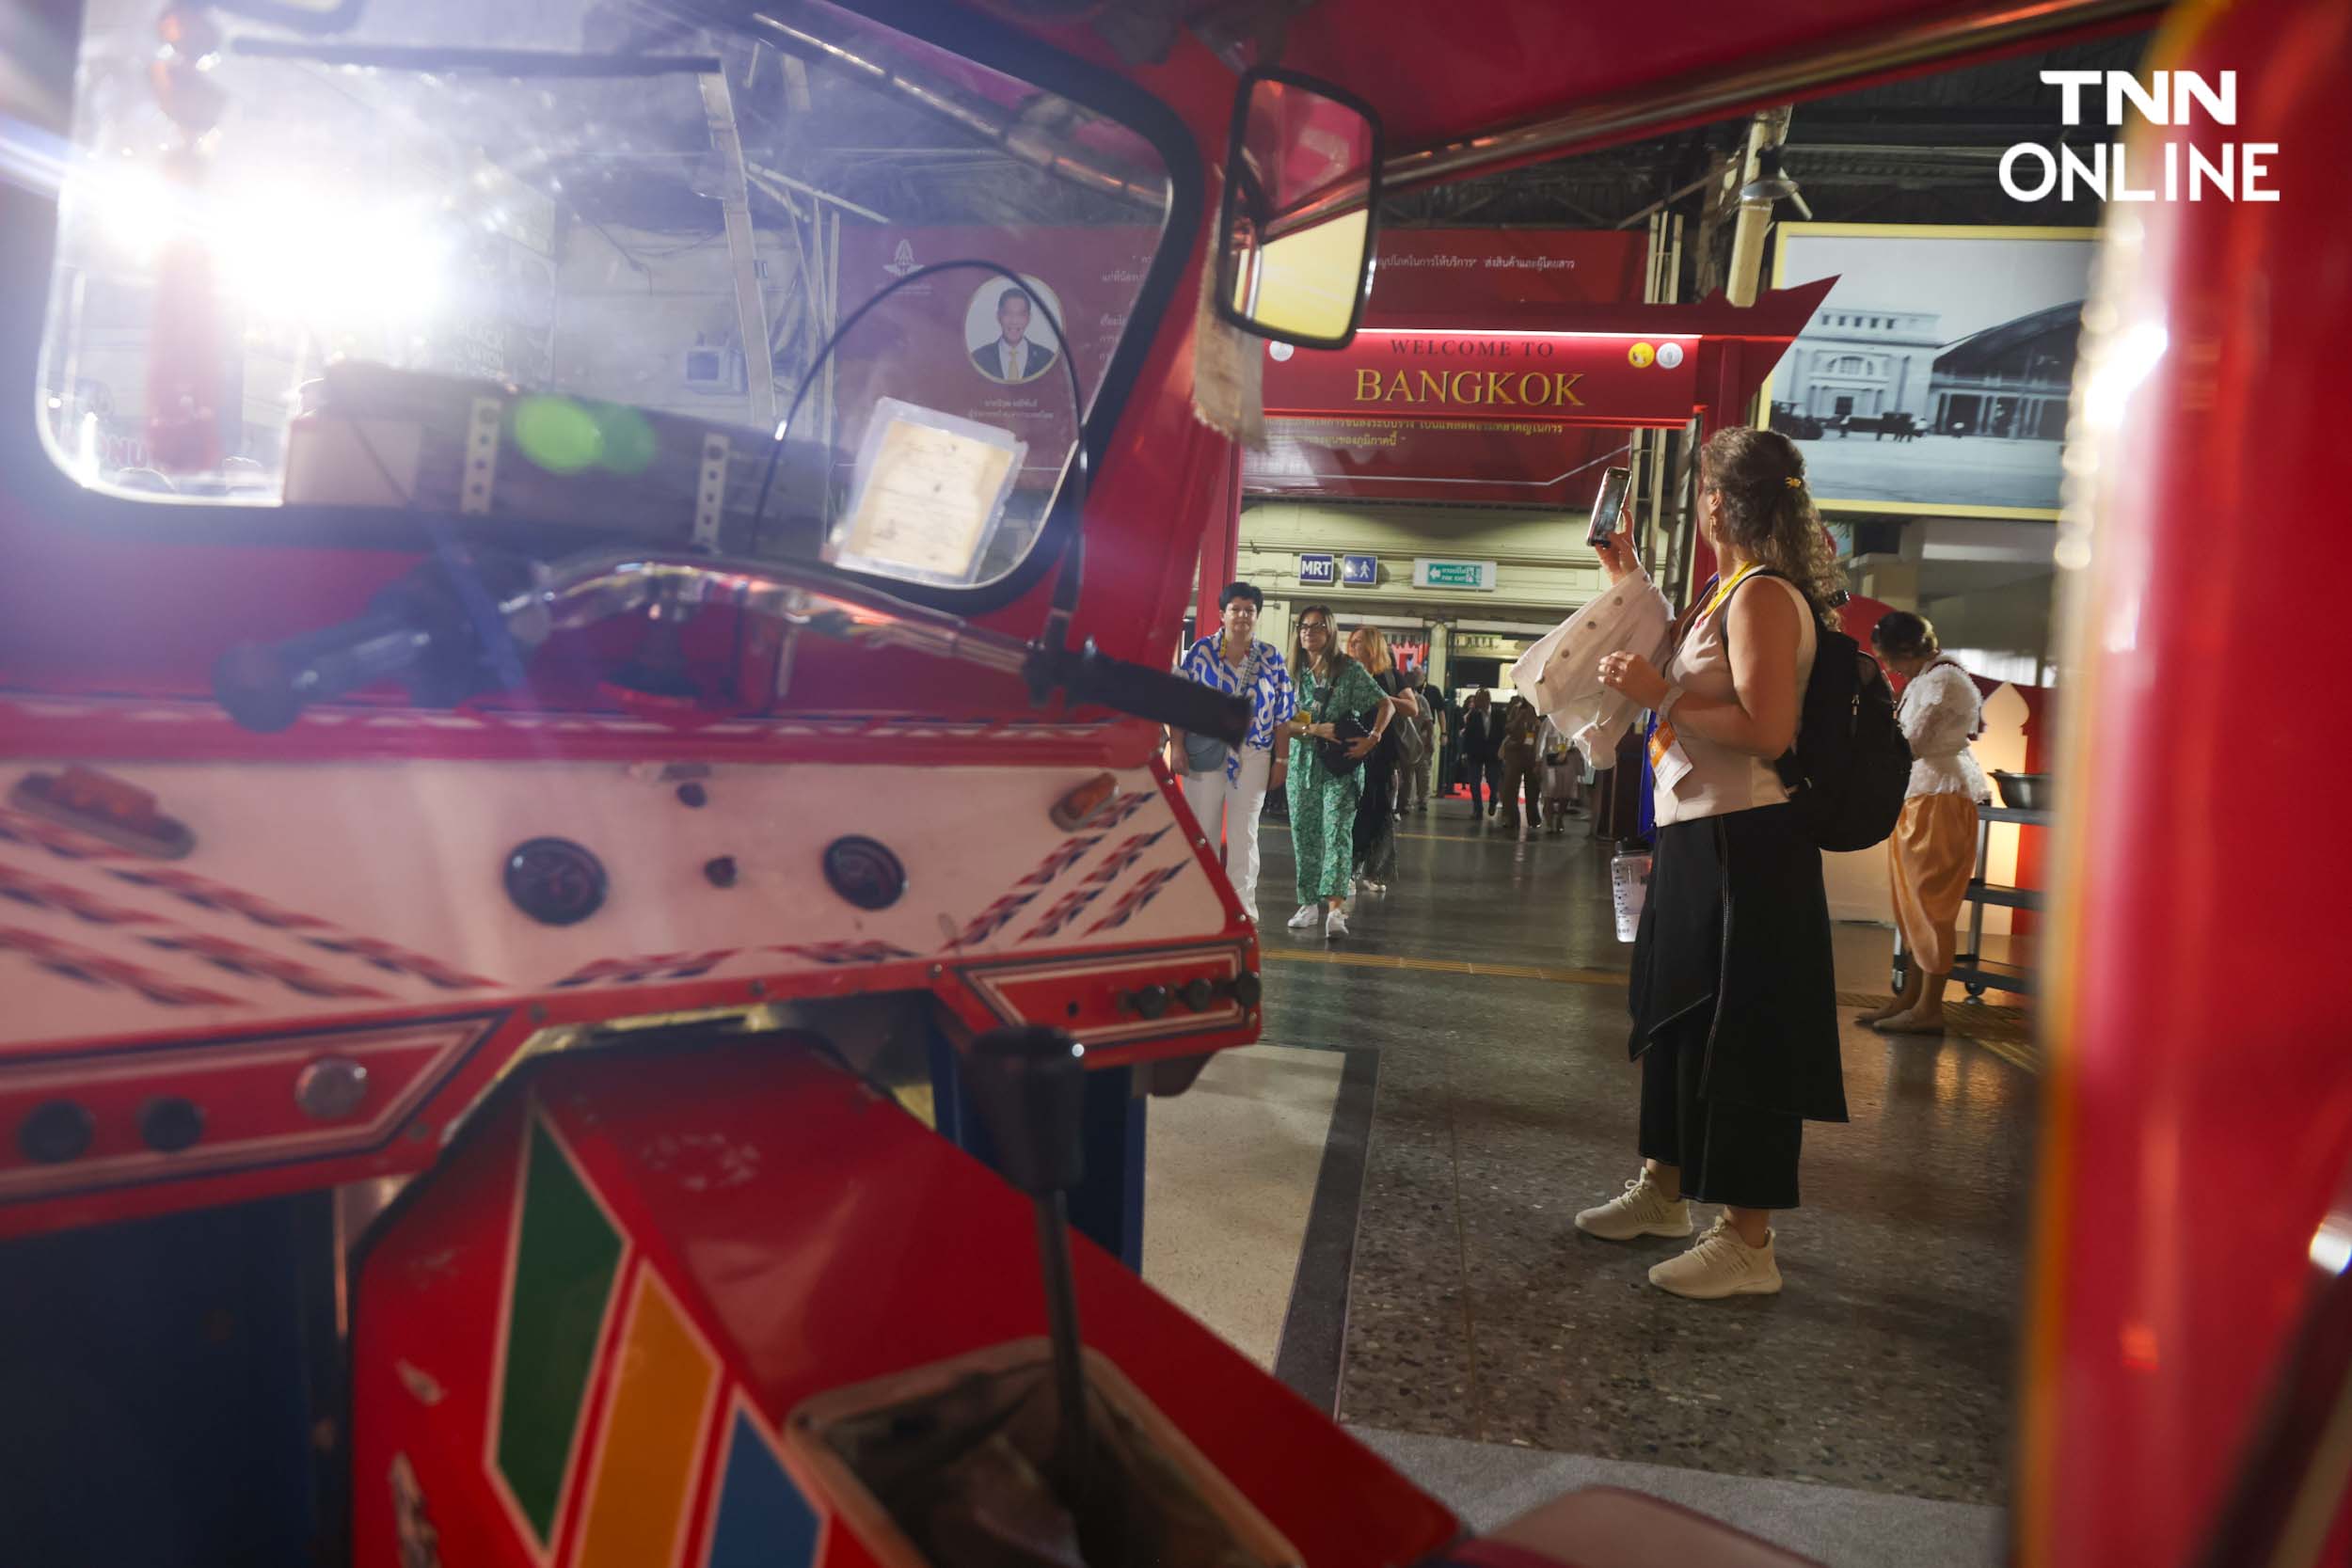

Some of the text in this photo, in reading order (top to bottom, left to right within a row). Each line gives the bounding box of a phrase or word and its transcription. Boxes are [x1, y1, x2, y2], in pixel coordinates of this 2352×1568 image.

[1391, 339, 1554, 358] WELCOME TO
[1354, 368, 1586, 406] BANGKOK
[1302, 560, 1331, 576] MRT
